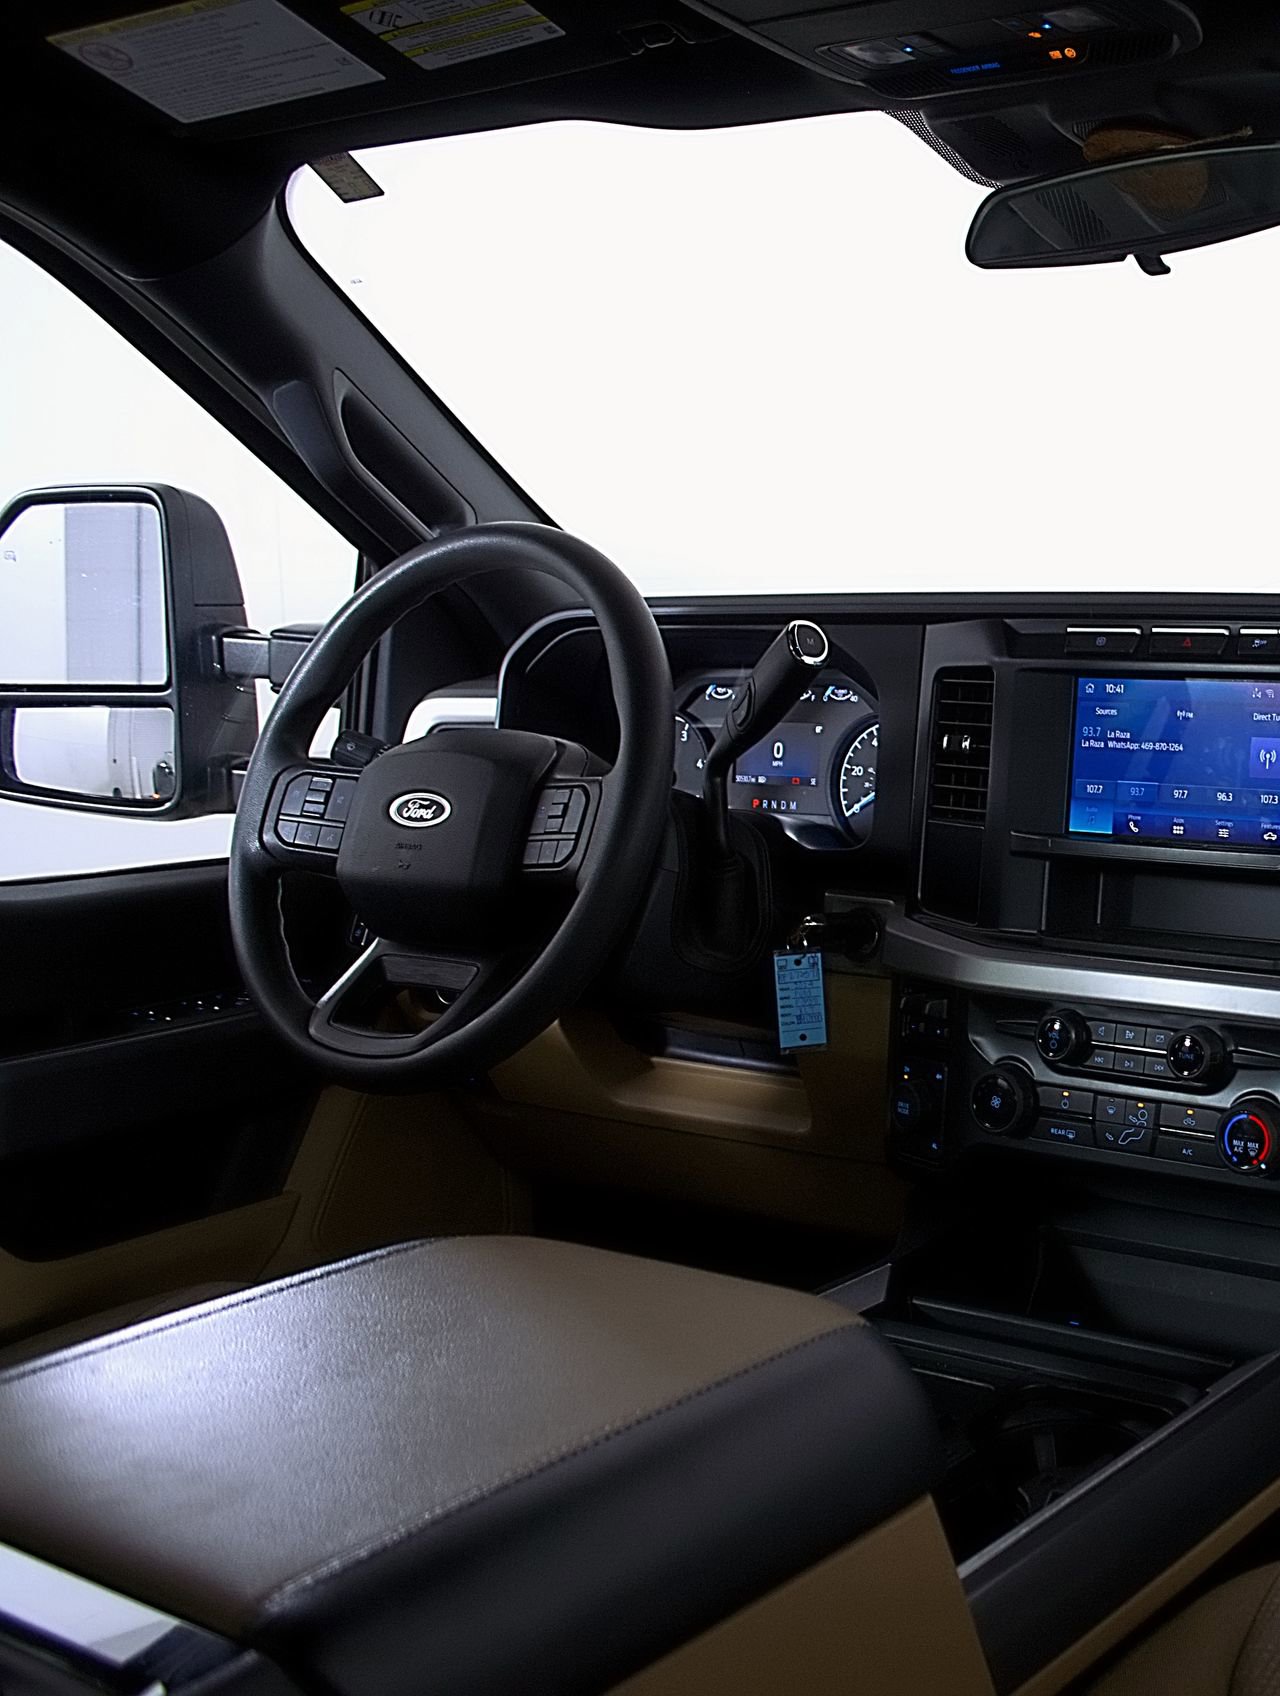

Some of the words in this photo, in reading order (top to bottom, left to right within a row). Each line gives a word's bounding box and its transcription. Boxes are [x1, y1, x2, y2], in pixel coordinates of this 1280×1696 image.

[1105, 684, 1124, 694] 10:41
[1095, 707, 1118, 716] Sources
[1253, 713, 1271, 721] Direct
[680, 730, 688, 742] 3
[1082, 726, 1101, 737] 93.7
[1107, 730, 1115, 738] La
[1116, 730, 1131, 739] Raza
[1081, 739, 1089, 747] La
[1090, 740, 1105, 748] Raza
[773, 741, 784, 759] 0
[696, 758, 704, 769] 4
[851, 765, 863, 776] 20
[1086, 784, 1103, 794] 107.7
[1130, 787, 1145, 796] 93.7
[1173, 789, 1188, 799] 97.7
[1216, 792, 1233, 802] 96.3
[1260, 795, 1279, 805] 107.3
[402, 799, 437, 819] Ford
[752, 799, 760, 809] P
[762, 800, 769, 809] R
[771, 800, 777, 809] N
[780, 800, 787, 810] D
[789, 801, 797, 810] M
[1215, 819, 1234, 828] Settings
[1260, 822, 1280, 830] Features
[1050, 1127, 1066, 1136] REAR
[1232, 1138, 1245, 1146] MAX
[1247, 1141, 1260, 1149] MAX
[1182, 1147, 1193, 1156] A/C
